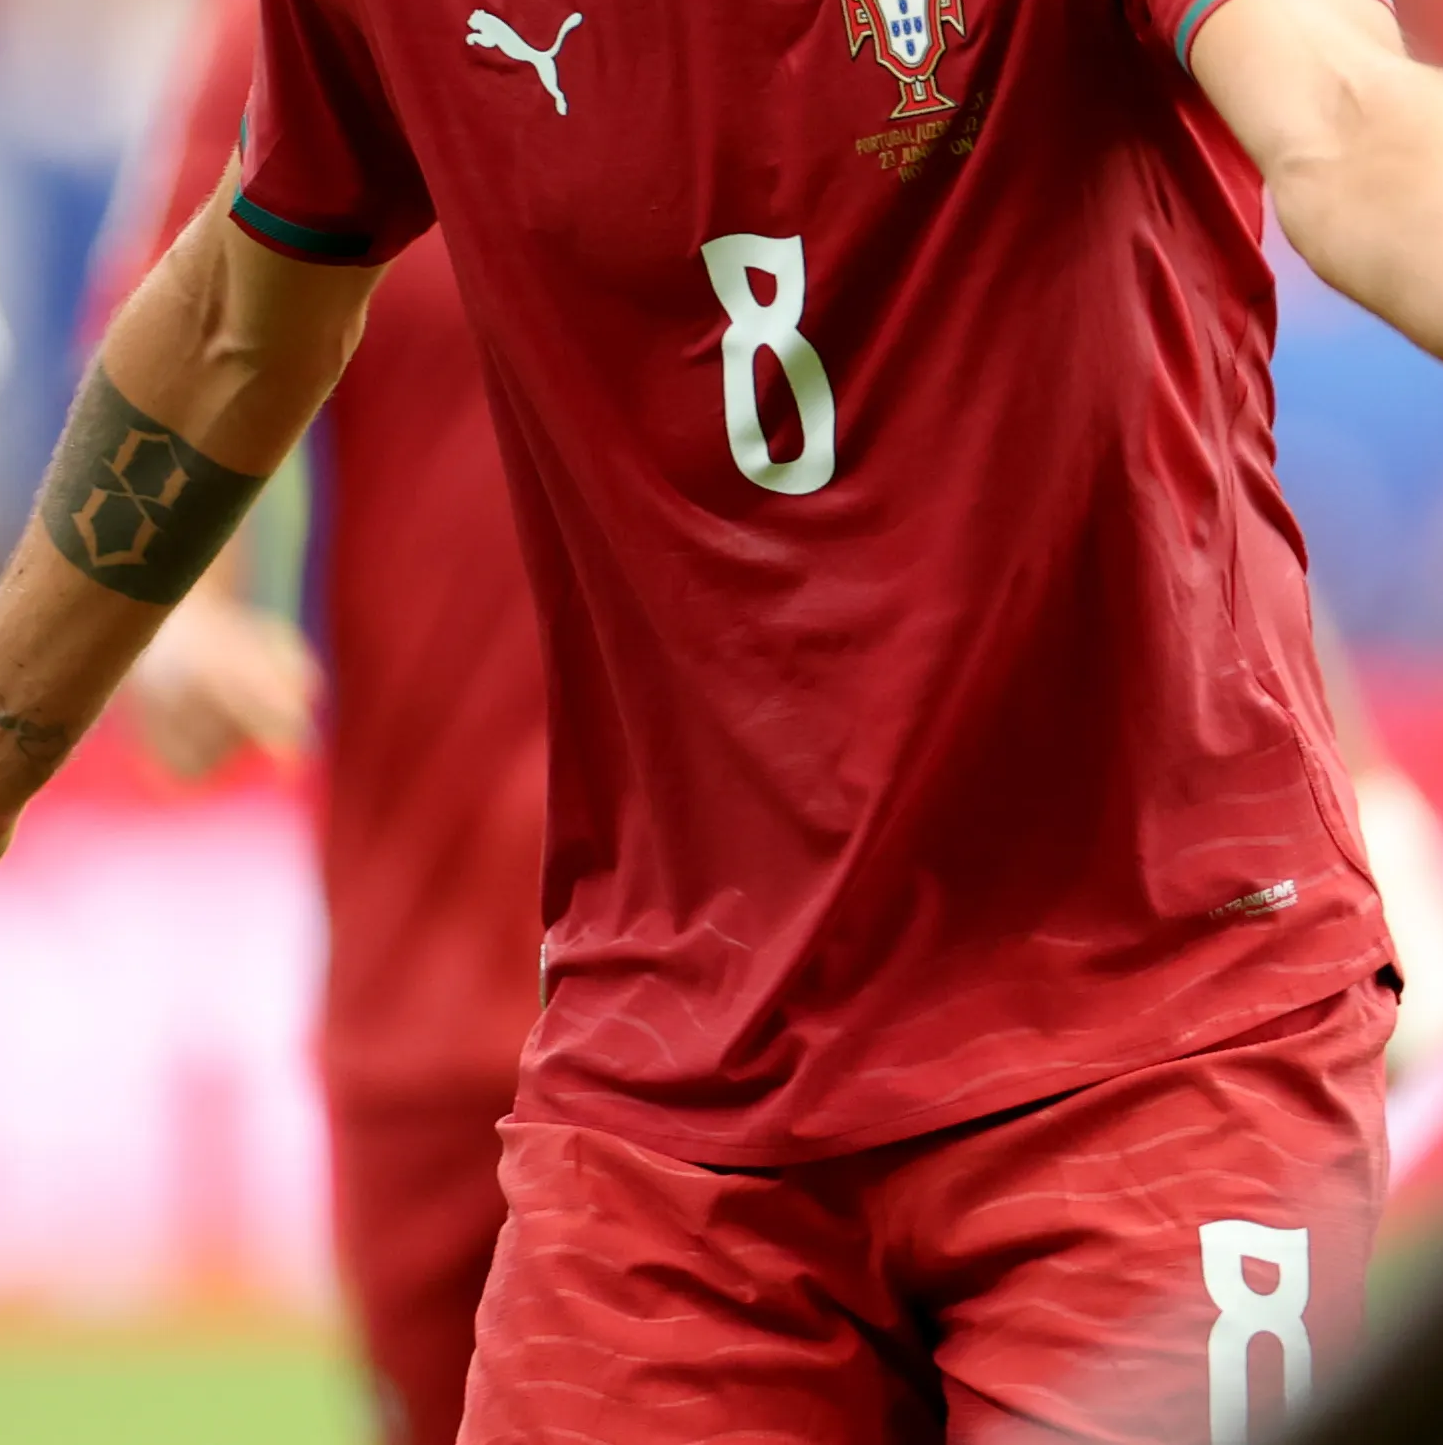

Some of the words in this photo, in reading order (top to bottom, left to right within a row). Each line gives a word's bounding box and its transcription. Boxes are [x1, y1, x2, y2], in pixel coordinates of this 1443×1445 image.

[878, 149, 896, 170] 23
[700, 233, 835, 495] 8
[1198, 1219, 1312, 1445] 8
